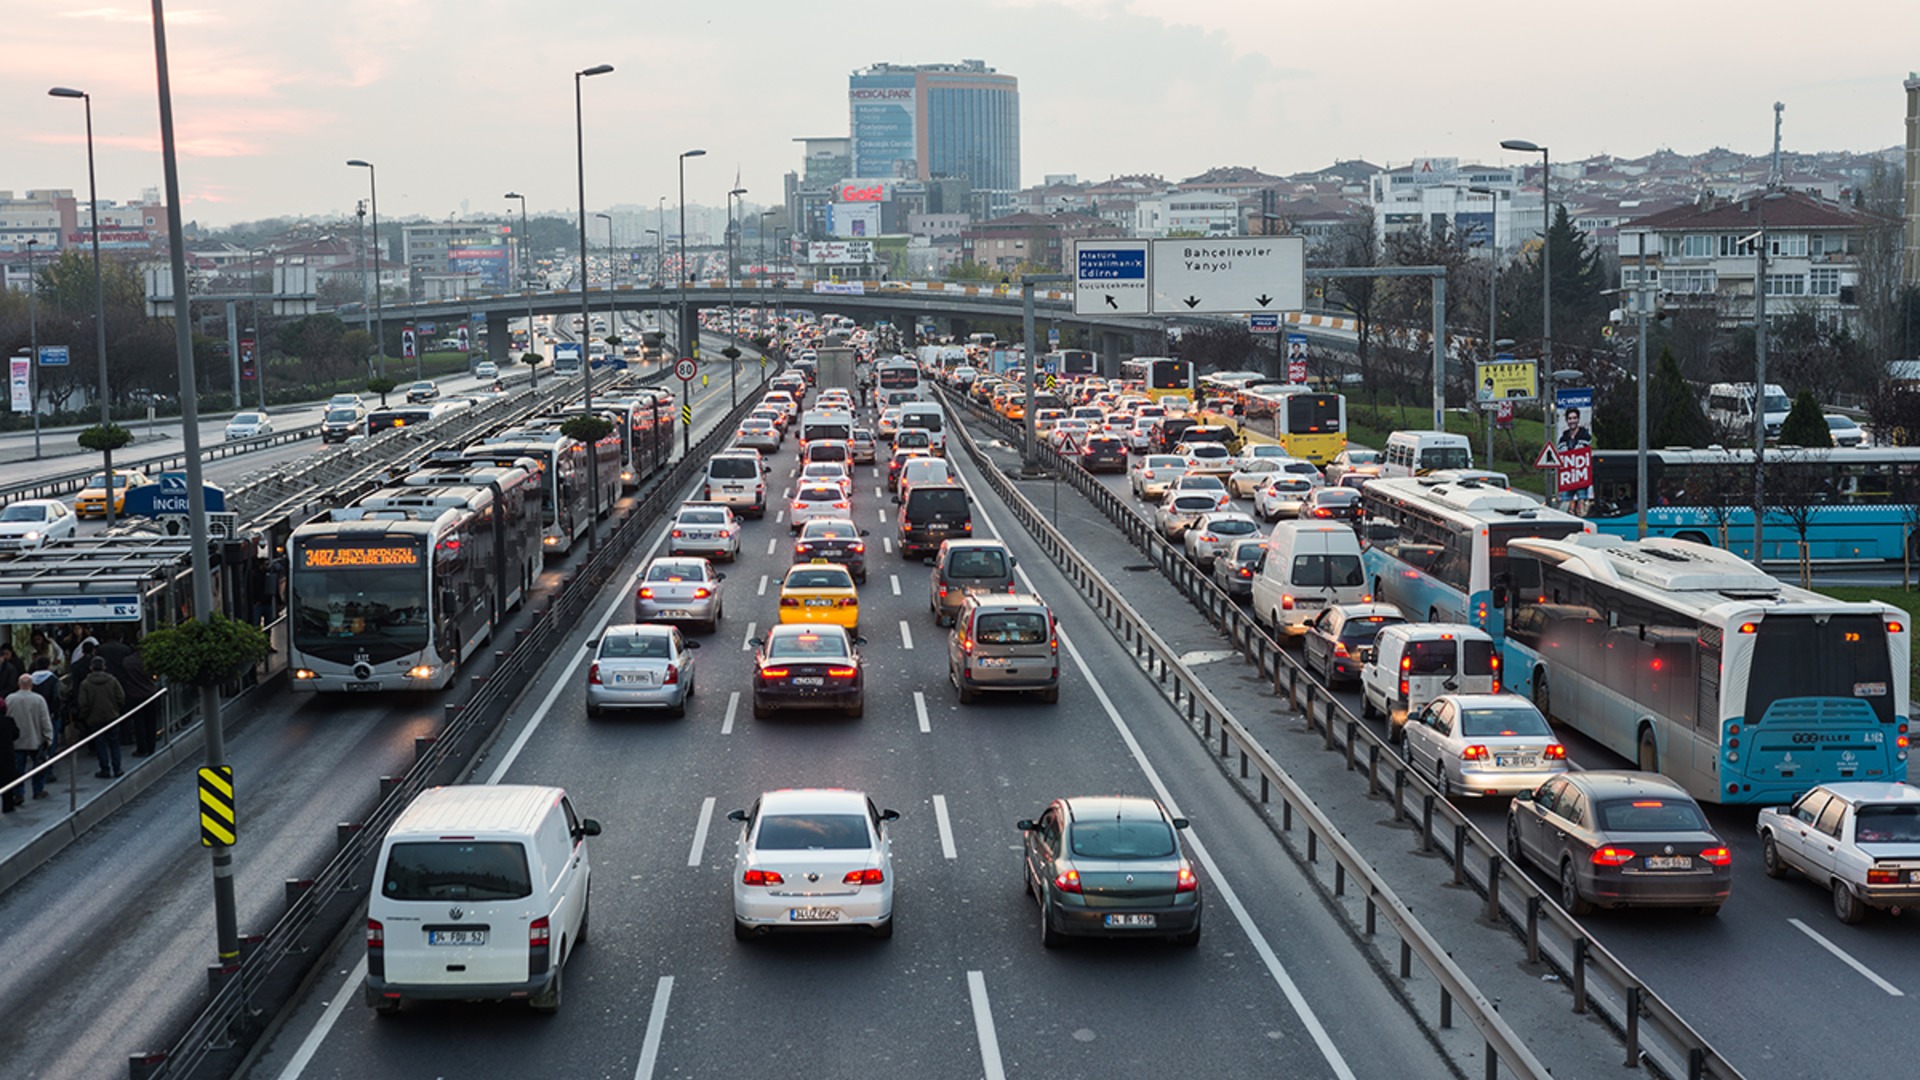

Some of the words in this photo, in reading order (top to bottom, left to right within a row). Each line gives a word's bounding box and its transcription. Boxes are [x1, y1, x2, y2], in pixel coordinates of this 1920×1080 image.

[842, 185, 883, 202] Gold
[1184, 247, 1272, 258] Bahçelievler
[1185, 261, 1232, 272] Yanyol
[1081, 269, 1119, 277] Edirne
[679, 364, 692, 375] 80
[1485, 364, 1527, 372] AVRUPA
[1560, 467, 1589, 485] RİM
